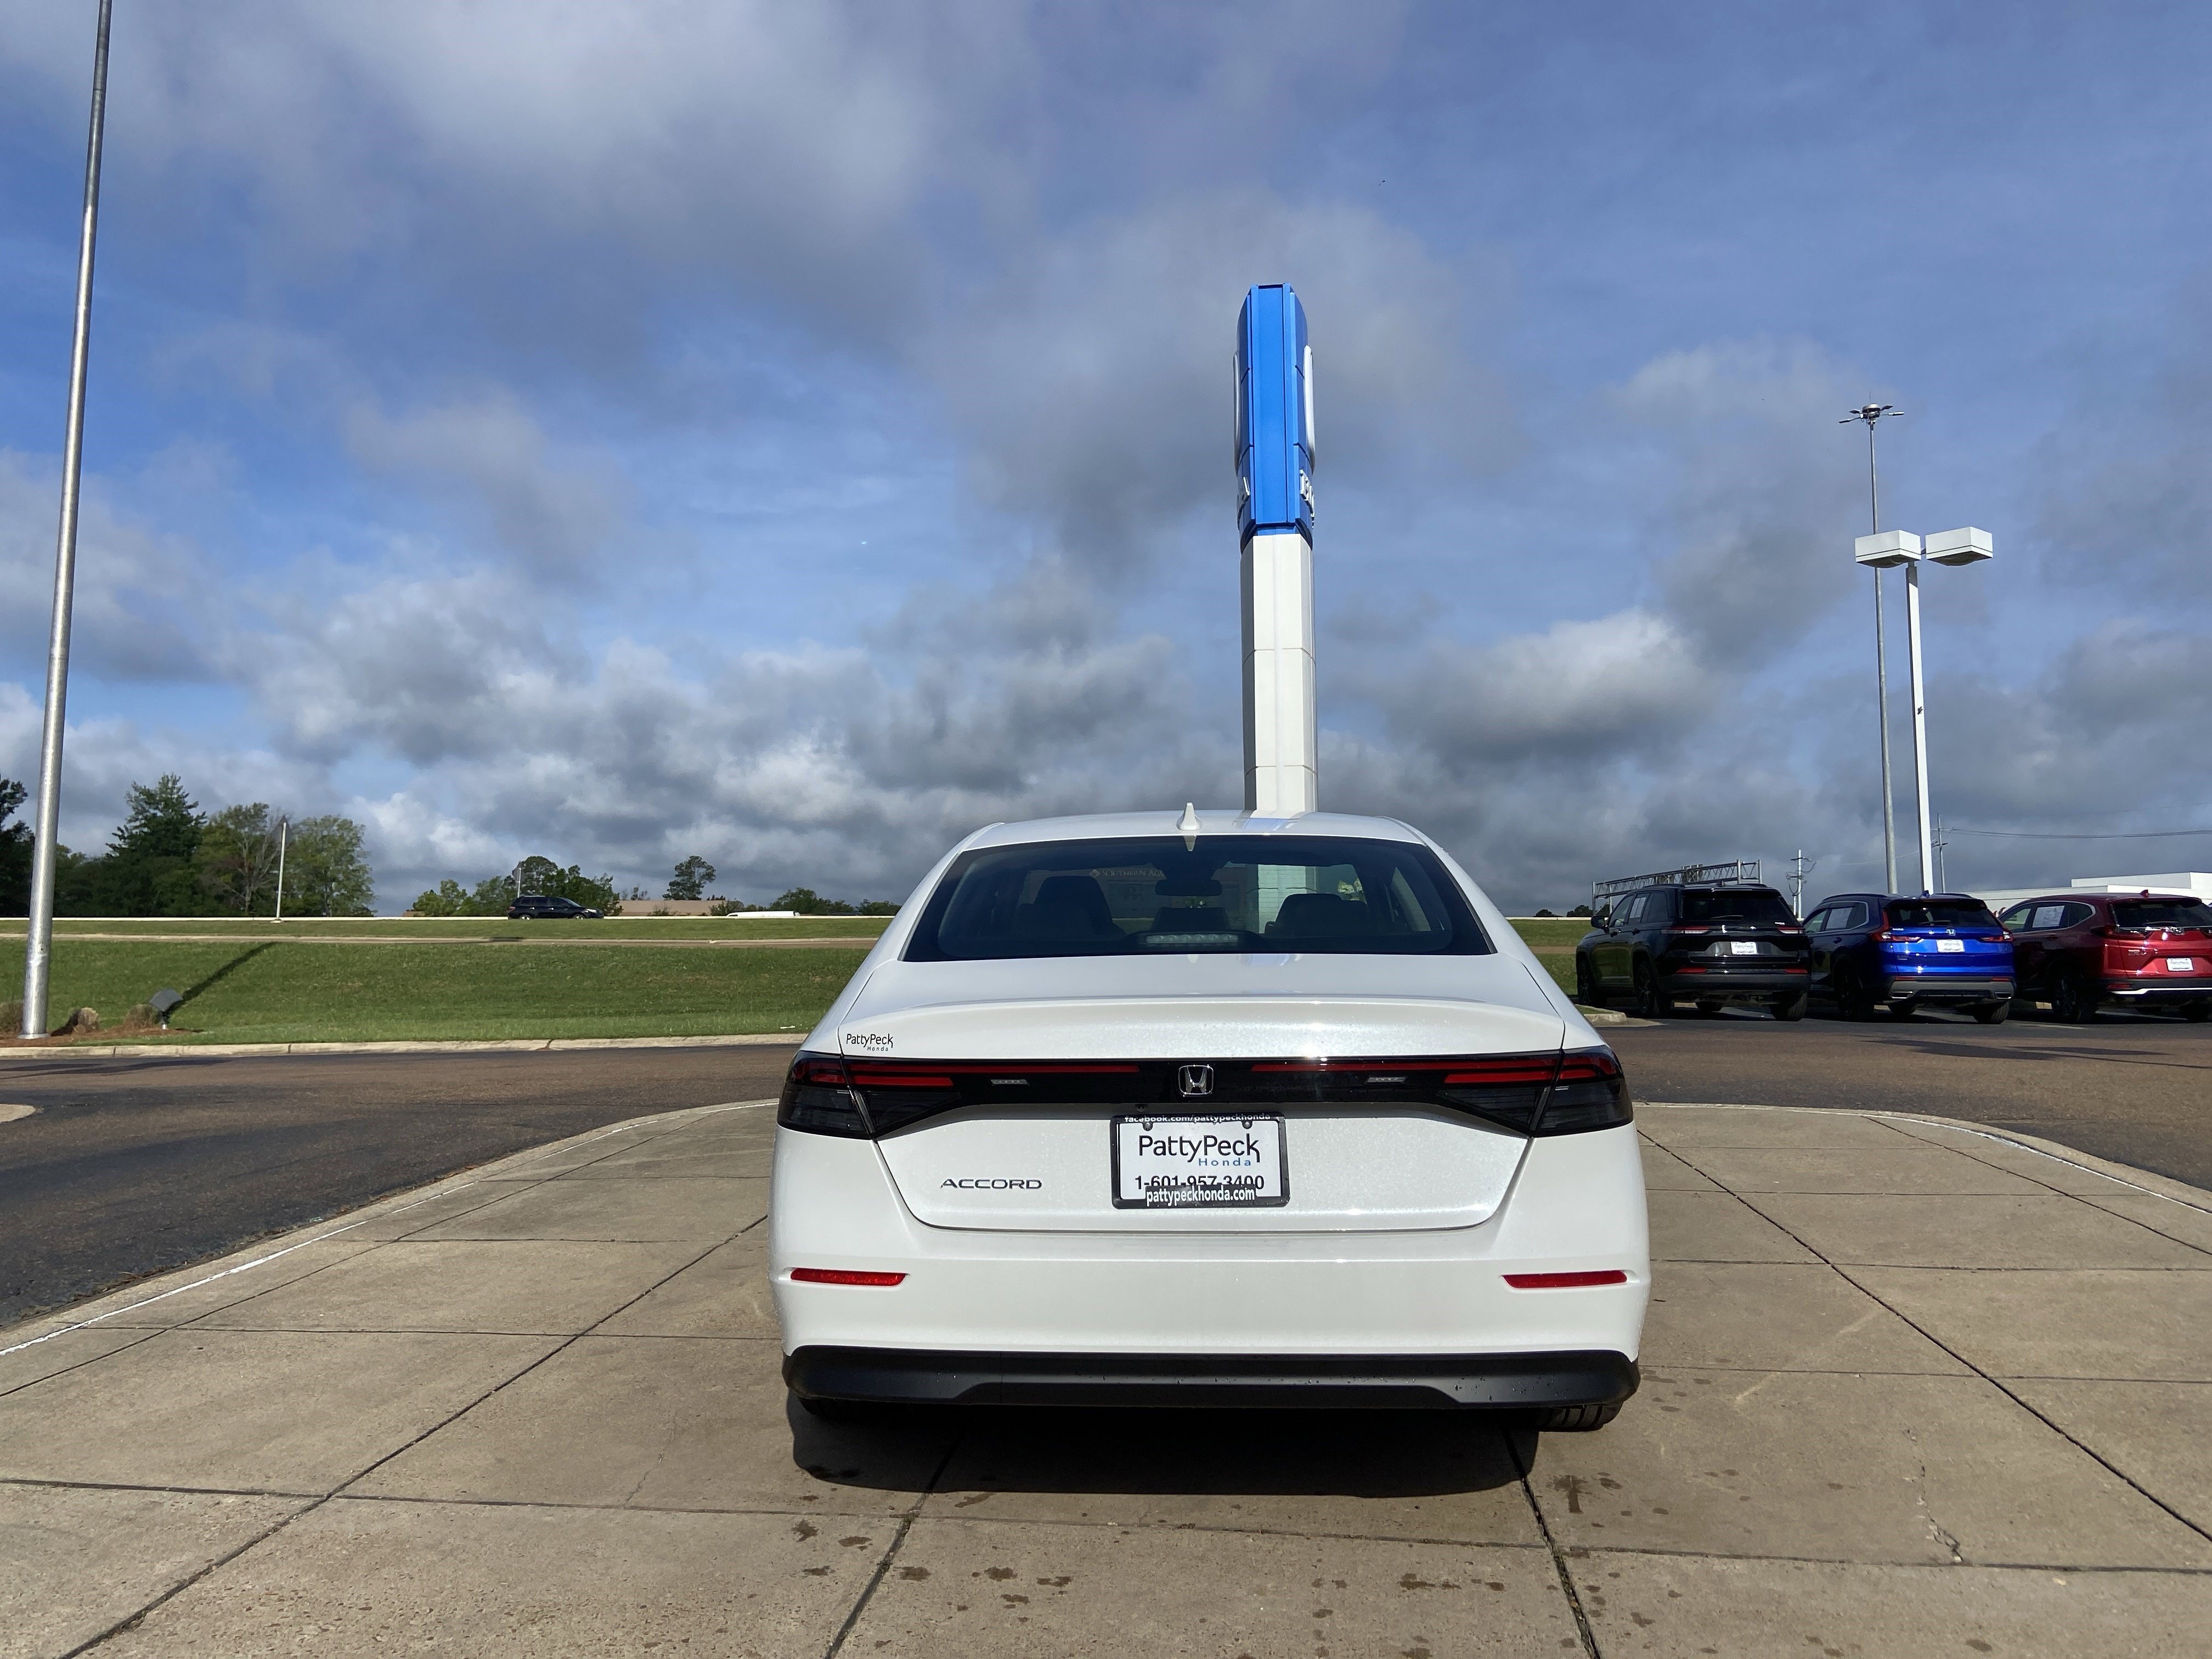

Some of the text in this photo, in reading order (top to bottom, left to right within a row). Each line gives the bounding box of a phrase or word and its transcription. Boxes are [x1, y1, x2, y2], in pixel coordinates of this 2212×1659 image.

[846, 1033, 894, 1048] PattyPeck
[1124, 1113, 1271, 1125] facebook.com/pattypeckhonda
[1139, 1133, 1261, 1163] PattyPeck
[1199, 1157, 1251, 1166] Honda
[939, 1178, 1042, 1189] ACCORD
[1147, 1184, 1255, 1207] pattypeckhonda.com
